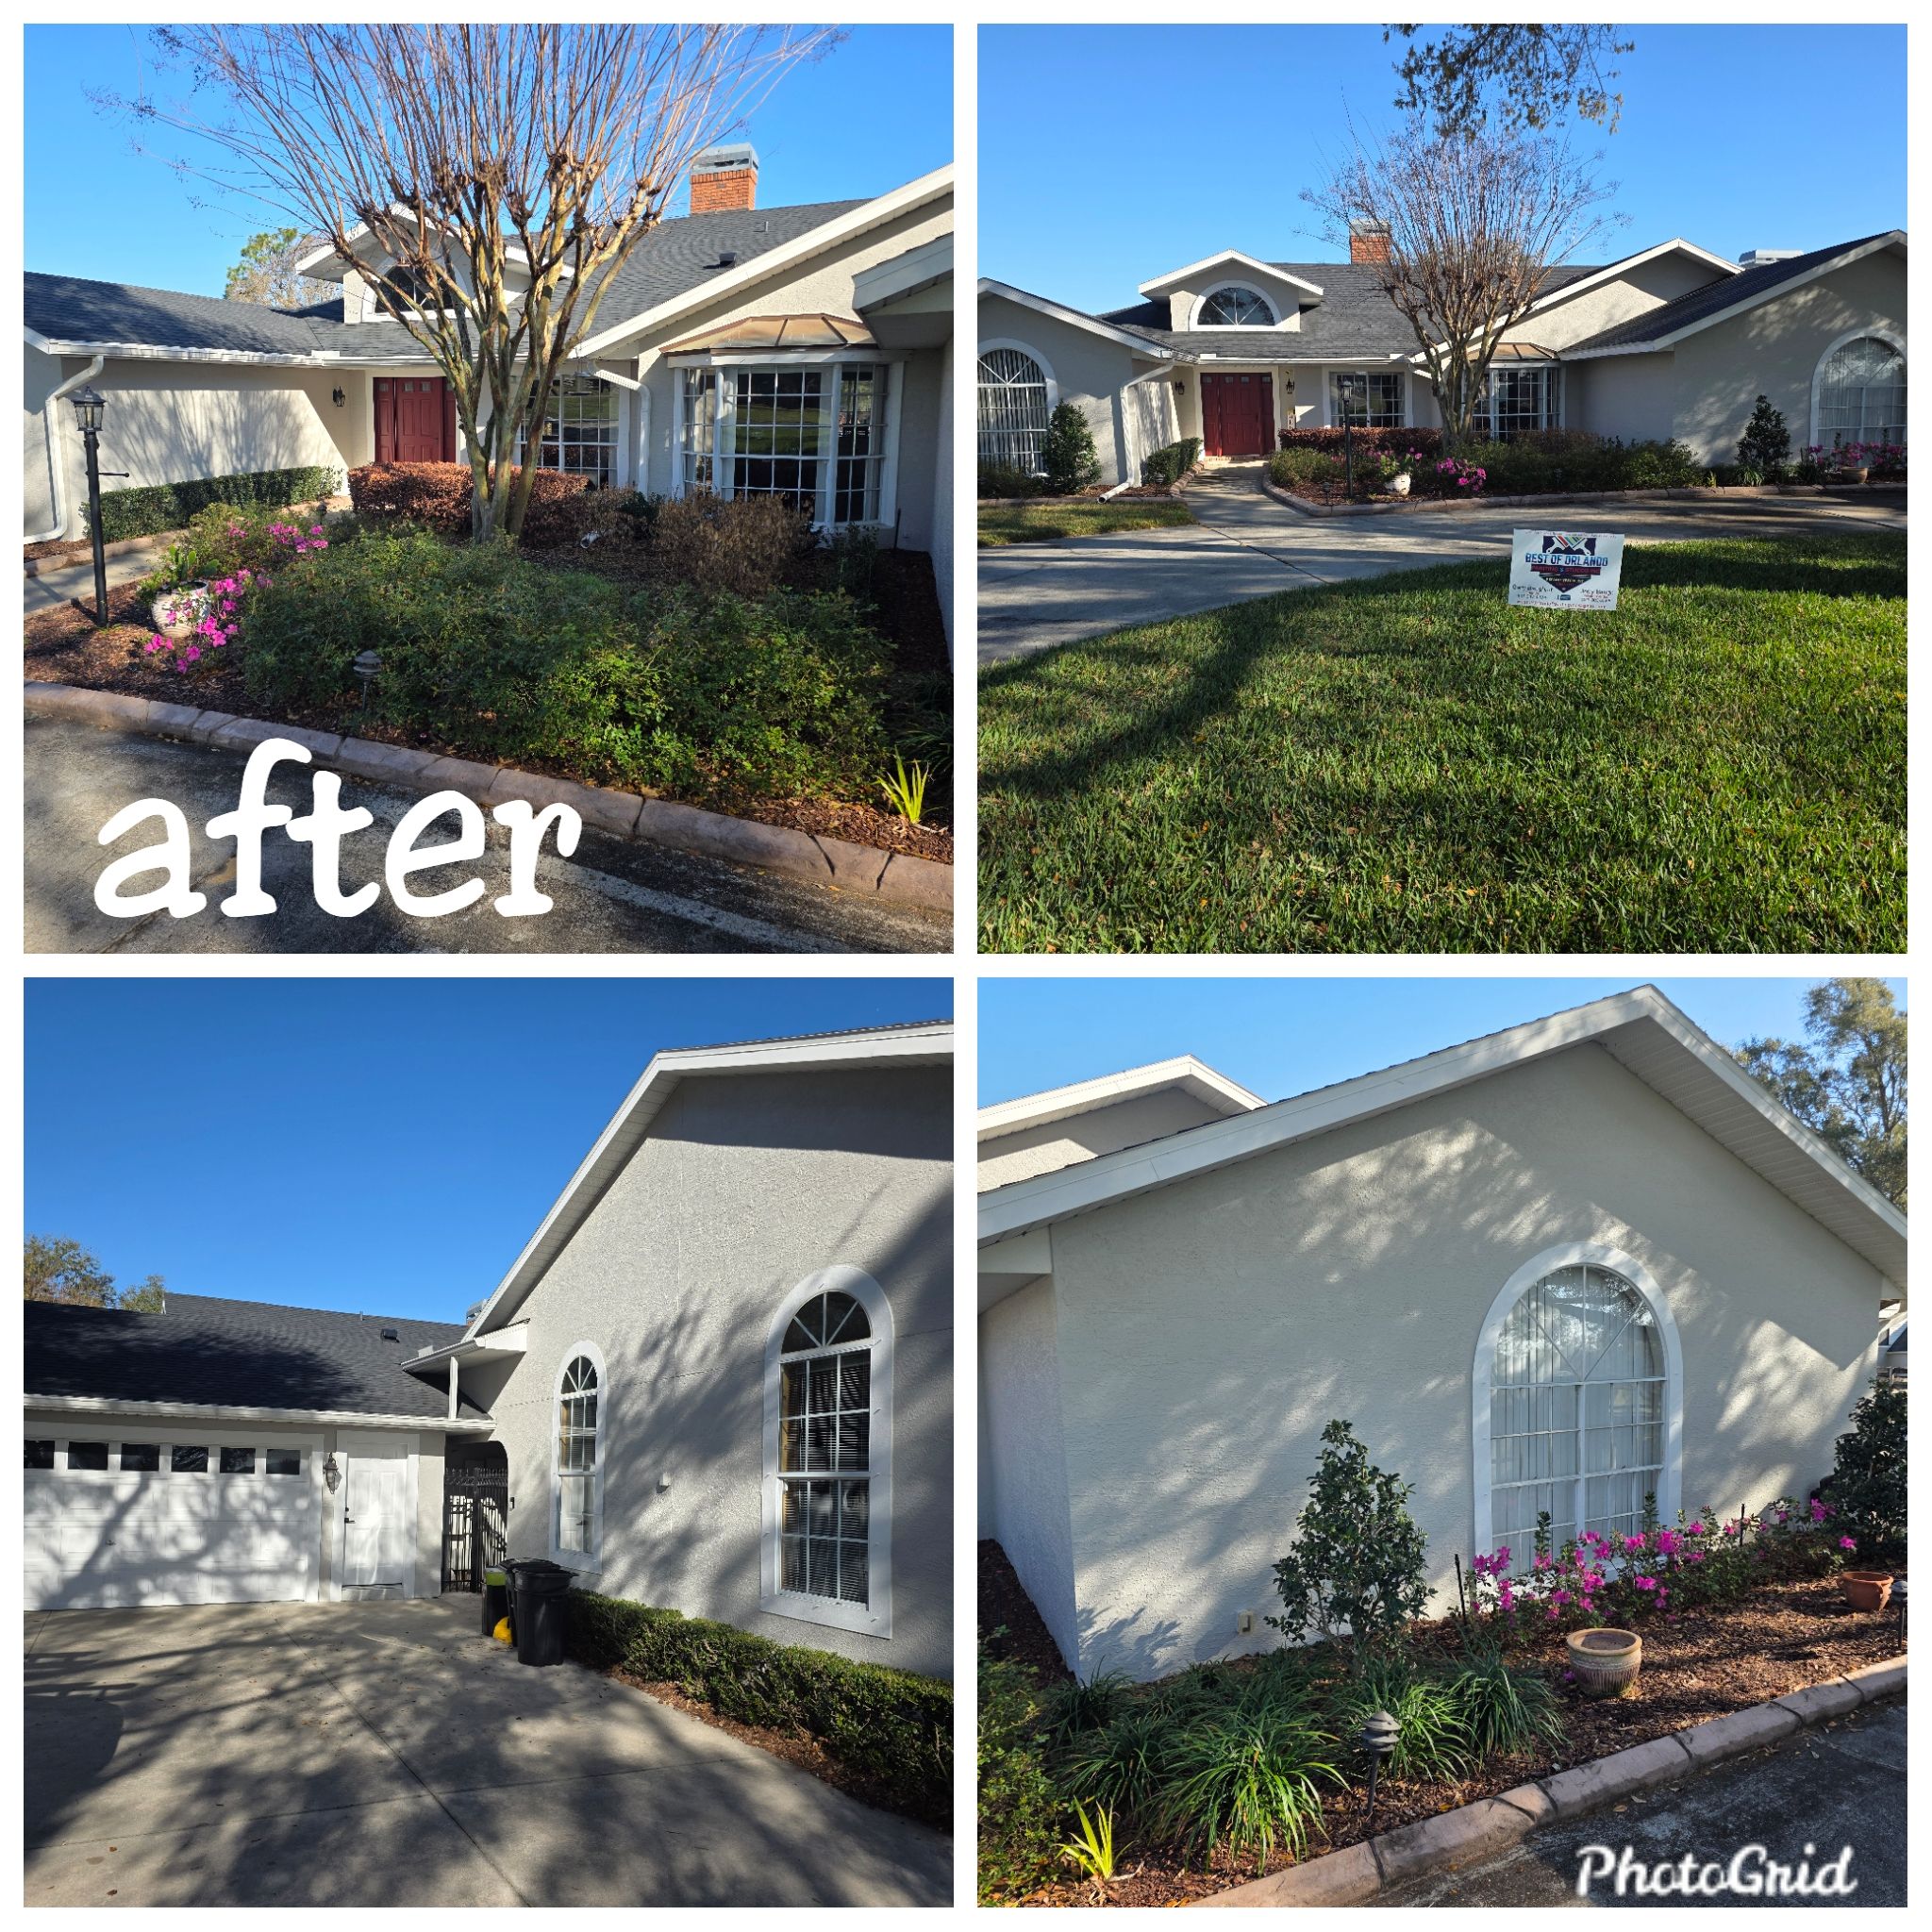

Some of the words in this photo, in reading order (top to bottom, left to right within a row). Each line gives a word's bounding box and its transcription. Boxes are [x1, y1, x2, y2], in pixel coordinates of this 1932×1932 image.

[1525, 553, 1549, 563] BEST
[1551, 554, 1562, 565] OF
[1565, 555, 1607, 566] ORLANDO
